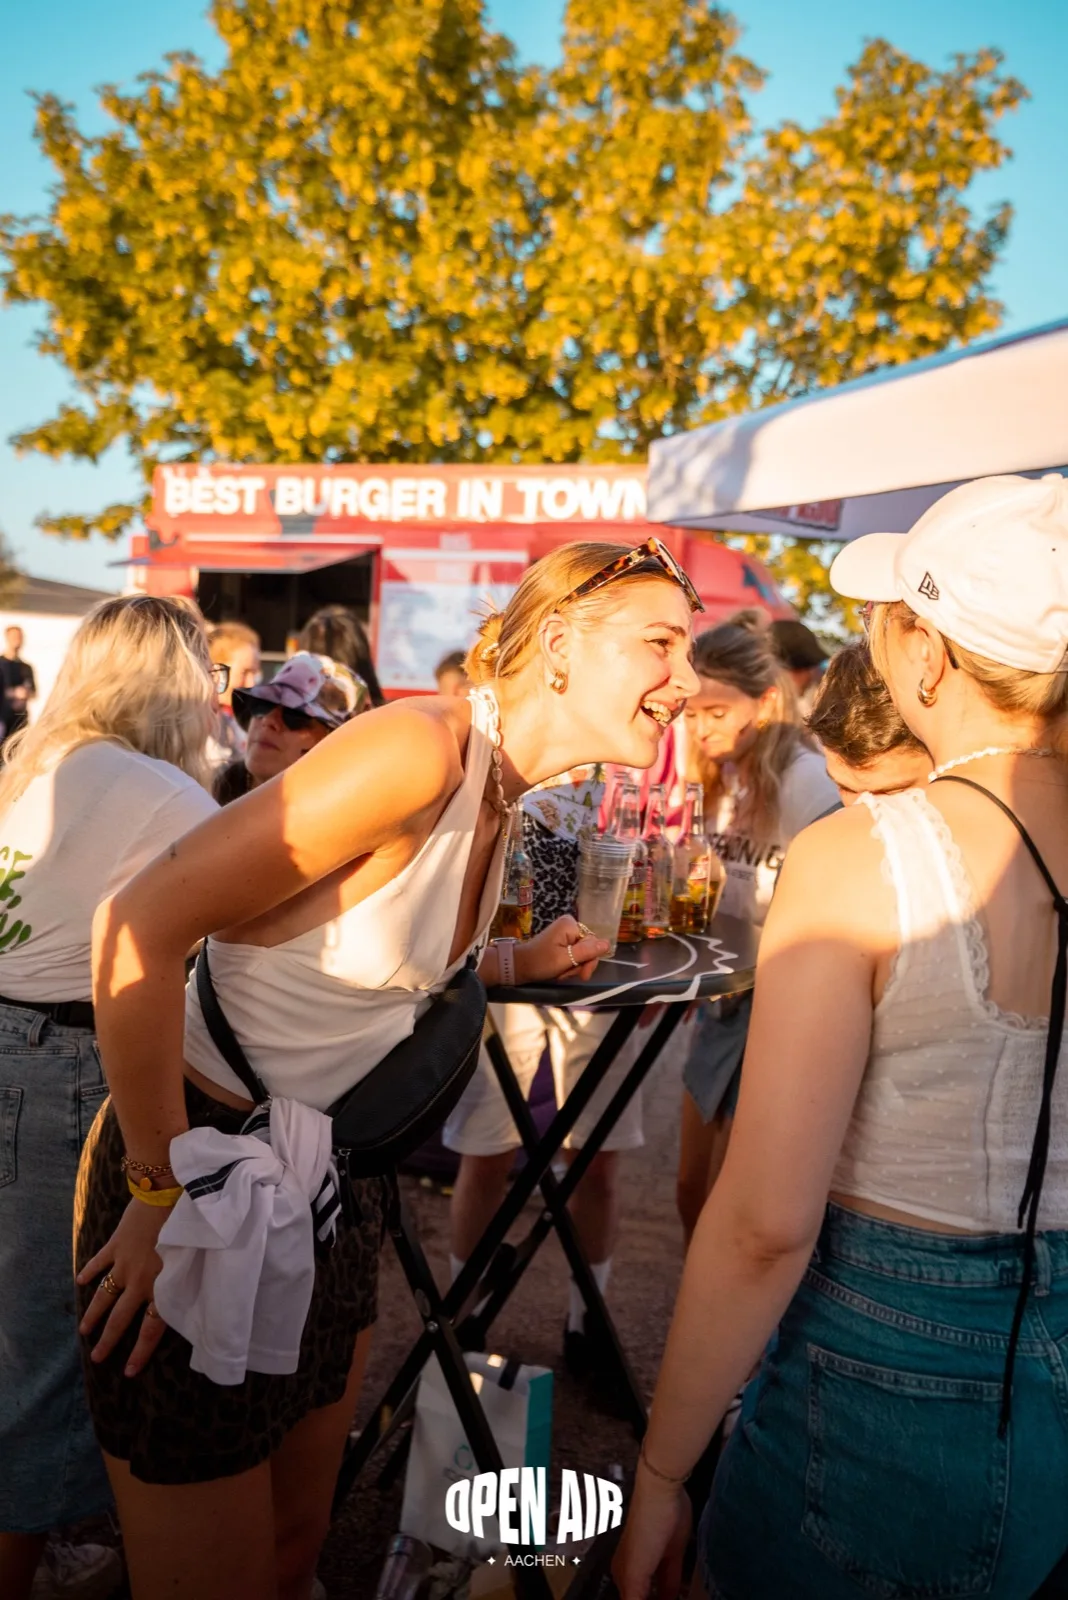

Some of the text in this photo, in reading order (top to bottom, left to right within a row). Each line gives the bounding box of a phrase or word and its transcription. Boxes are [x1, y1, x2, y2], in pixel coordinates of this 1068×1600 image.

[164, 474, 647, 522] BEST BURGER IN TOWN
